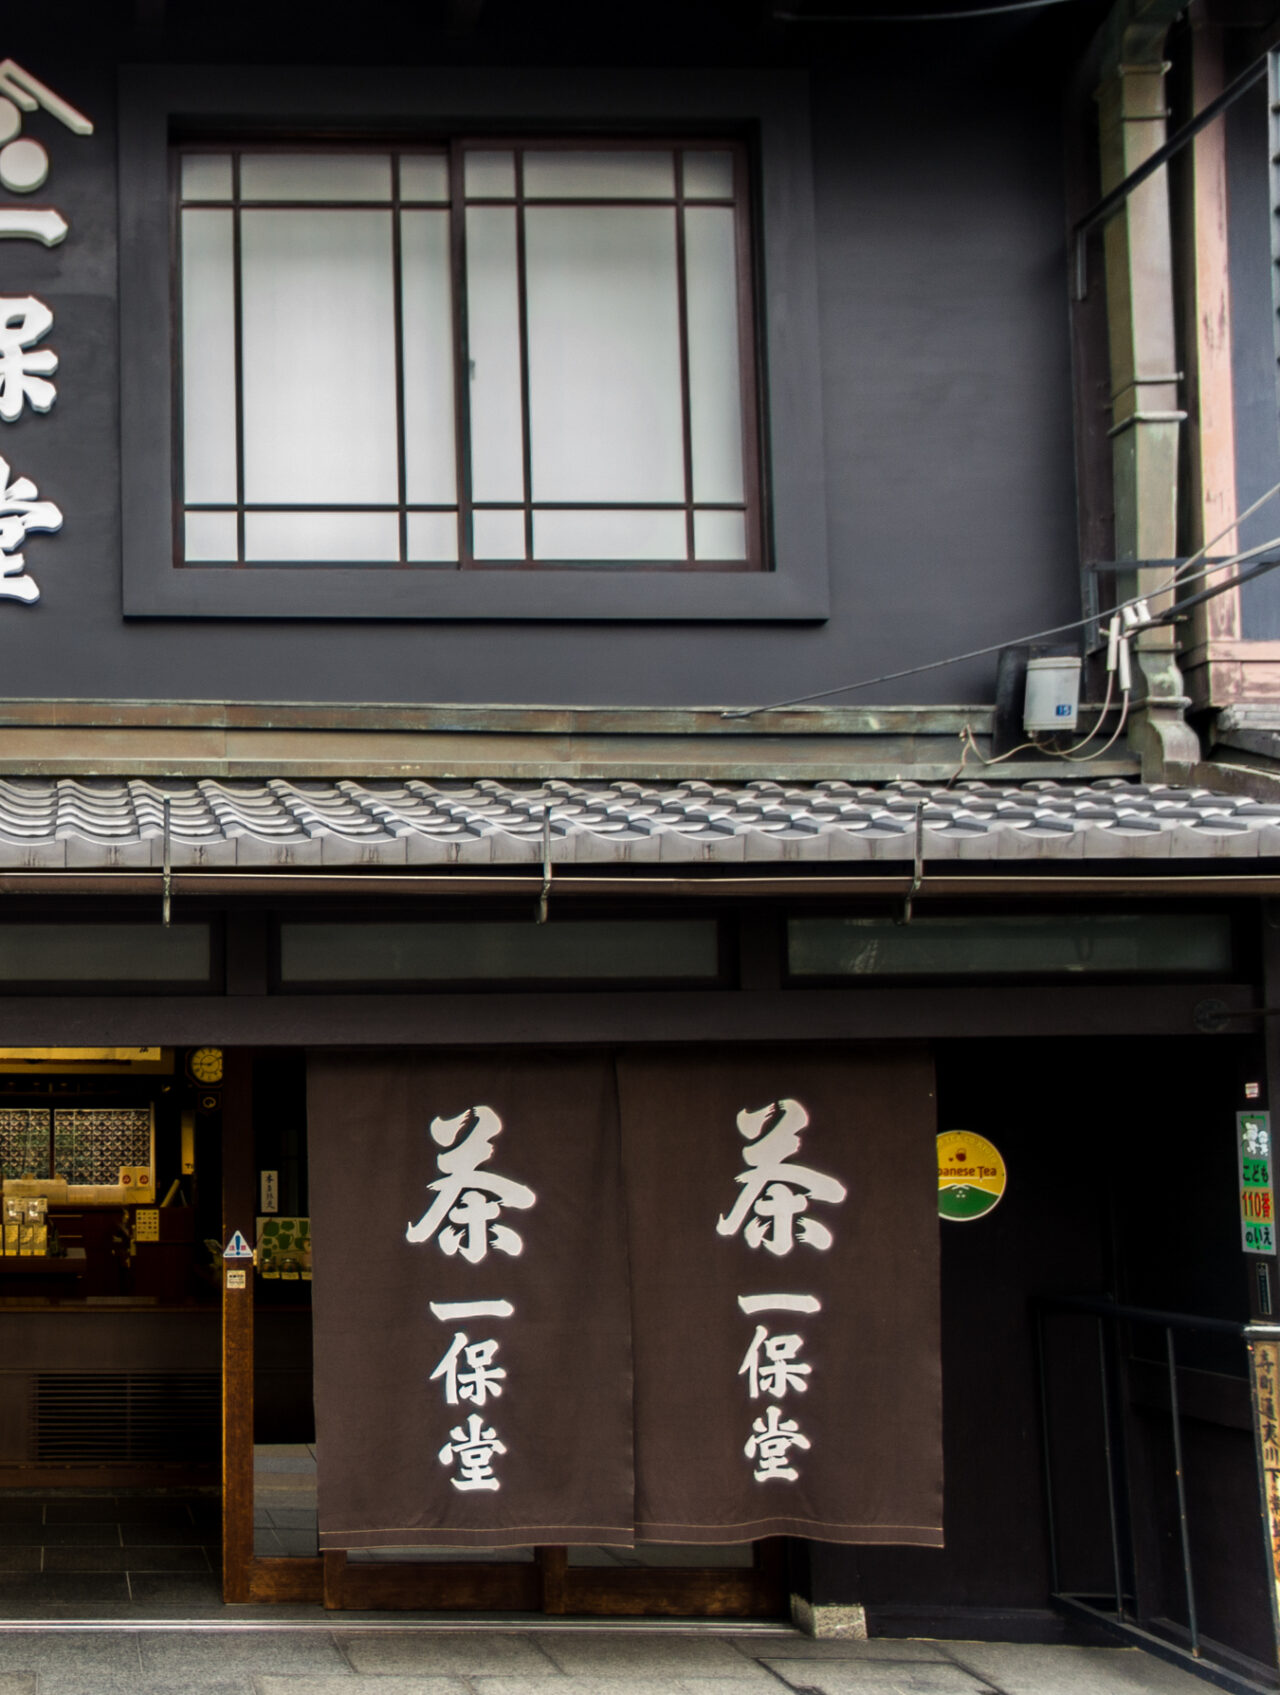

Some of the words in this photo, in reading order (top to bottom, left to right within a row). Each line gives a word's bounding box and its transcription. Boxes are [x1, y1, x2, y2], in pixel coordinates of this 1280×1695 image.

[938, 1167, 976, 1178] panese
[977, 1166, 997, 1180] Tea
[1243, 1164, 1269, 1183] こども
[1242, 1191, 1271, 1218] 110番
[1246, 1227, 1272, 1245] のいえ
